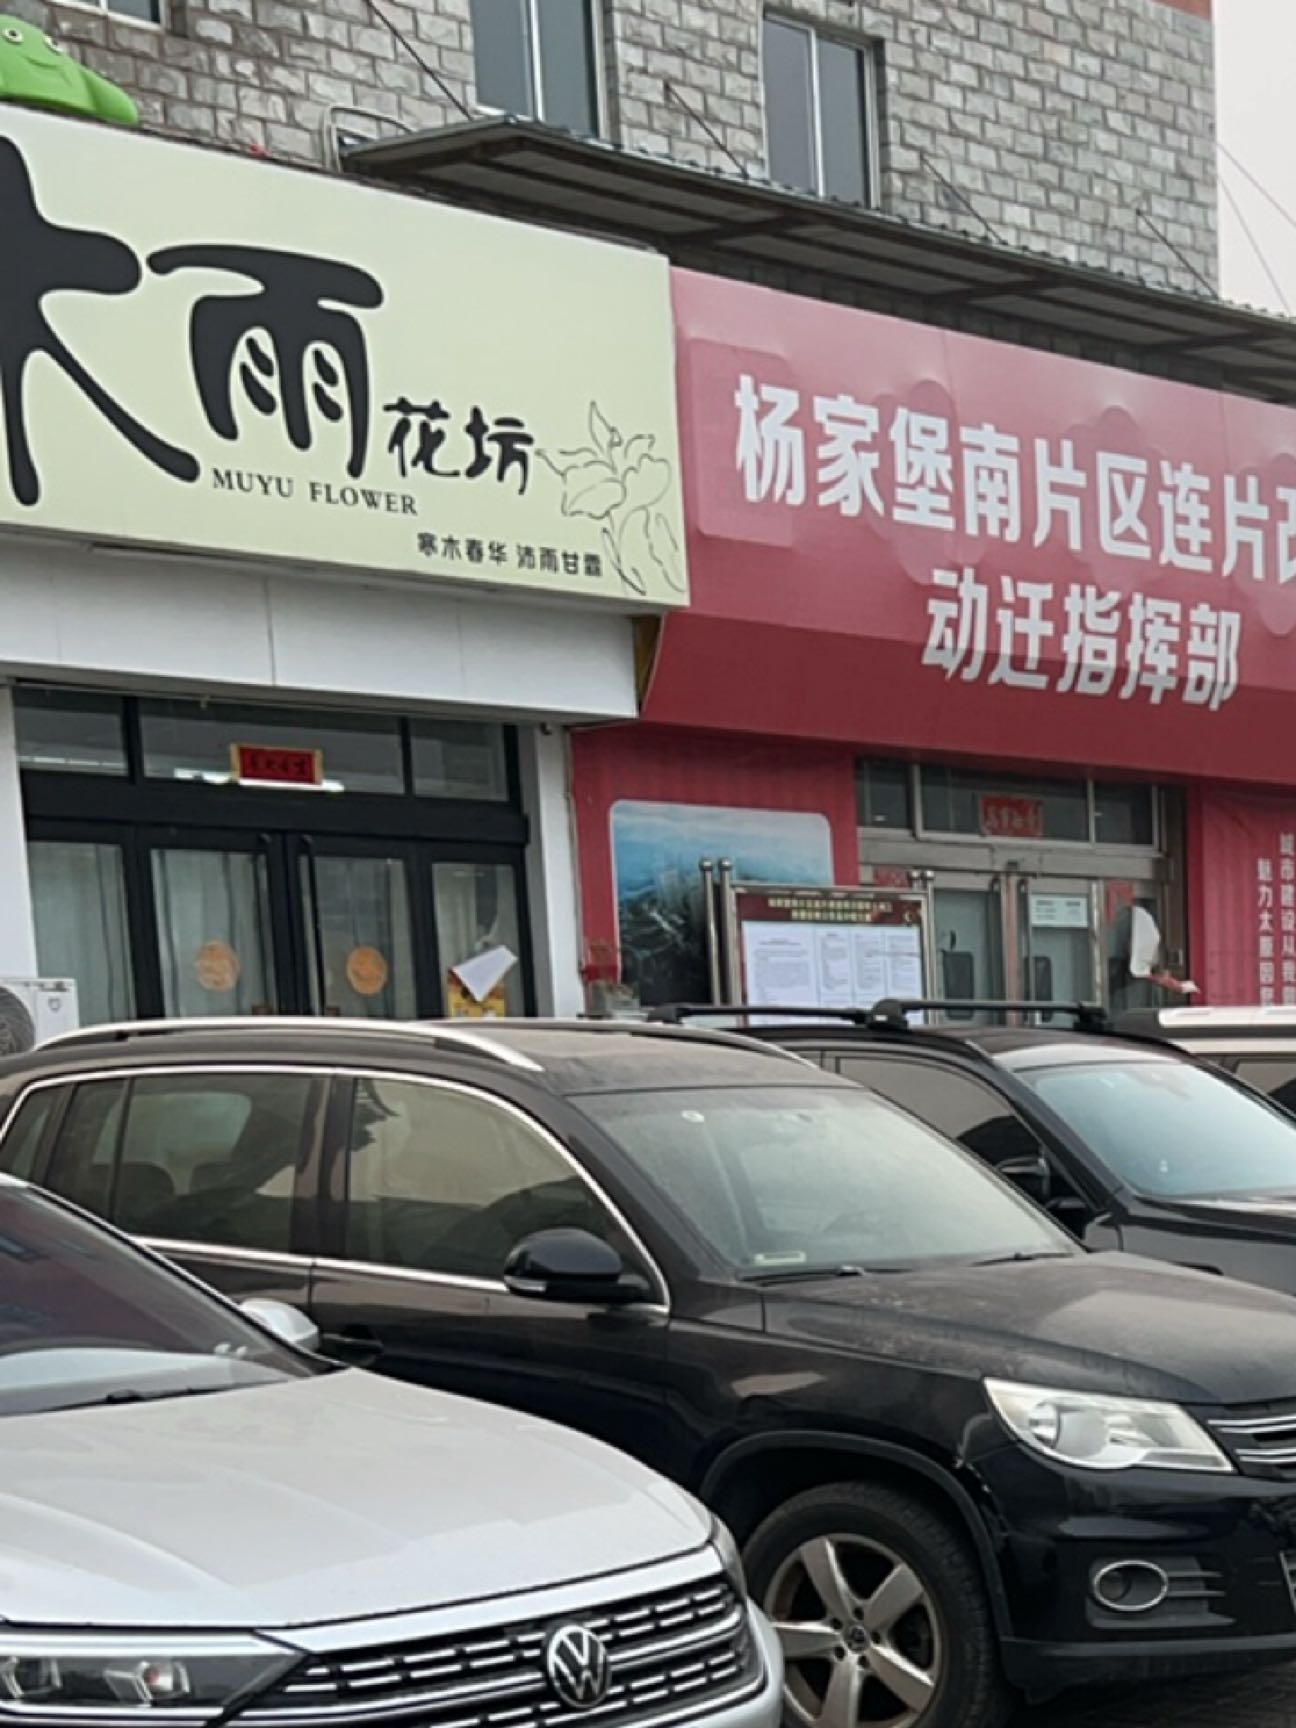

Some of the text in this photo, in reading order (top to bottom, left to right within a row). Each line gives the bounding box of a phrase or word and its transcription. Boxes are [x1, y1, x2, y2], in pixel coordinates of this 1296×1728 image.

[211, 467, 419, 516] MUYU FLOWER
[383, 396, 534, 496] 花坊
[921, 568, 1241, 712] 动迁指挥部
